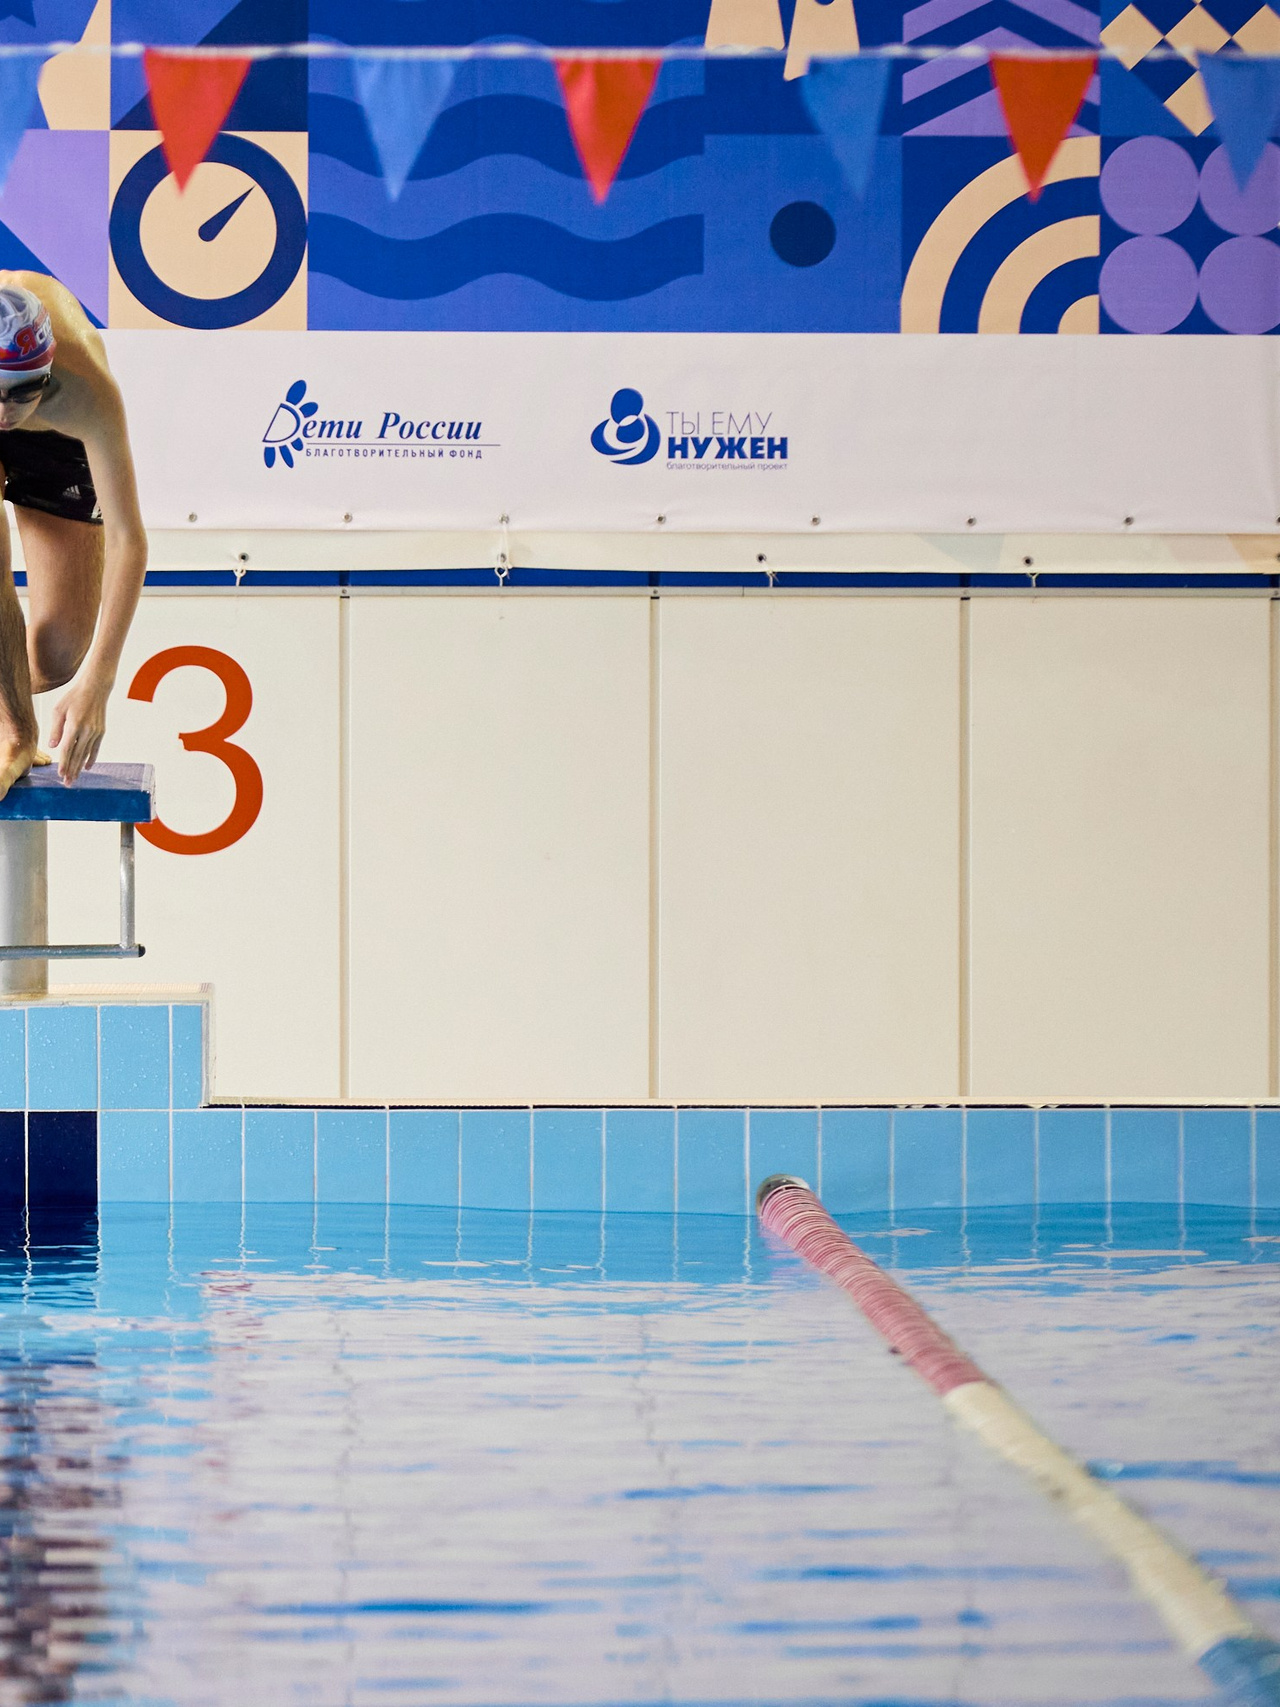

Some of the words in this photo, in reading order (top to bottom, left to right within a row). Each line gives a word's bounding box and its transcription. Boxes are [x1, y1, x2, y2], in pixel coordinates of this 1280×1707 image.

[375, 411, 483, 440] России
[665, 411, 701, 435] ТЫ
[711, 411, 773, 435] ЕМУ
[305, 448, 444, 459] БЛАГОТВОРИТЕЛЬНЫЙ
[449, 449, 483, 460] ФОНД
[667, 436, 788, 459] НУЖЕН
[666, 462, 756, 471] благотворительный
[127, 645, 264, 856] 3
